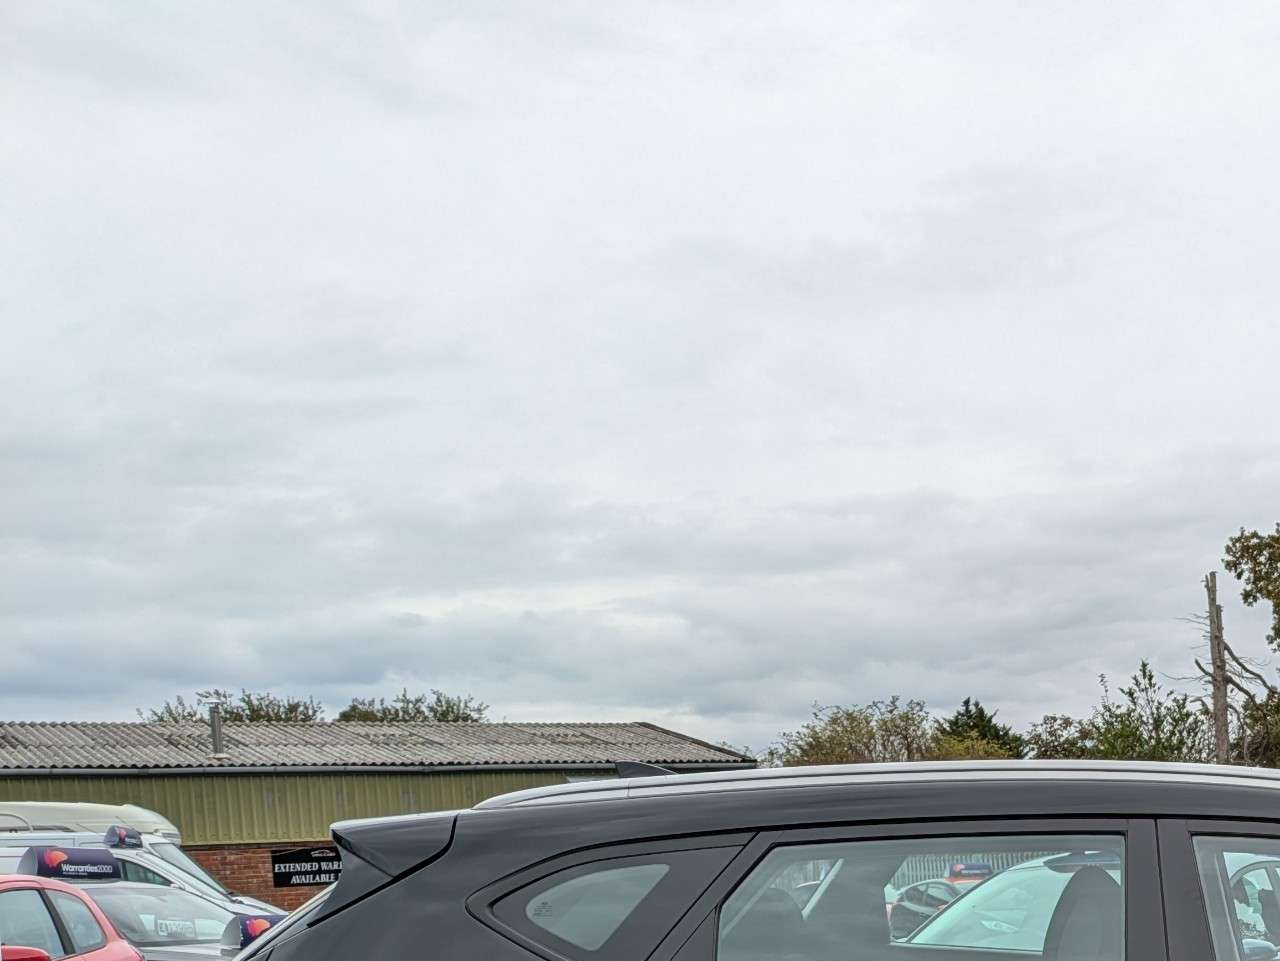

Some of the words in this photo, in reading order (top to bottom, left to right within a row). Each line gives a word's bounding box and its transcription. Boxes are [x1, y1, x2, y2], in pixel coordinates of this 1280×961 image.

[61, 863, 113, 873] Warranties2000
[274, 862, 319, 873] EXTENDED
[290, 873, 336, 885] AVAILABLE
